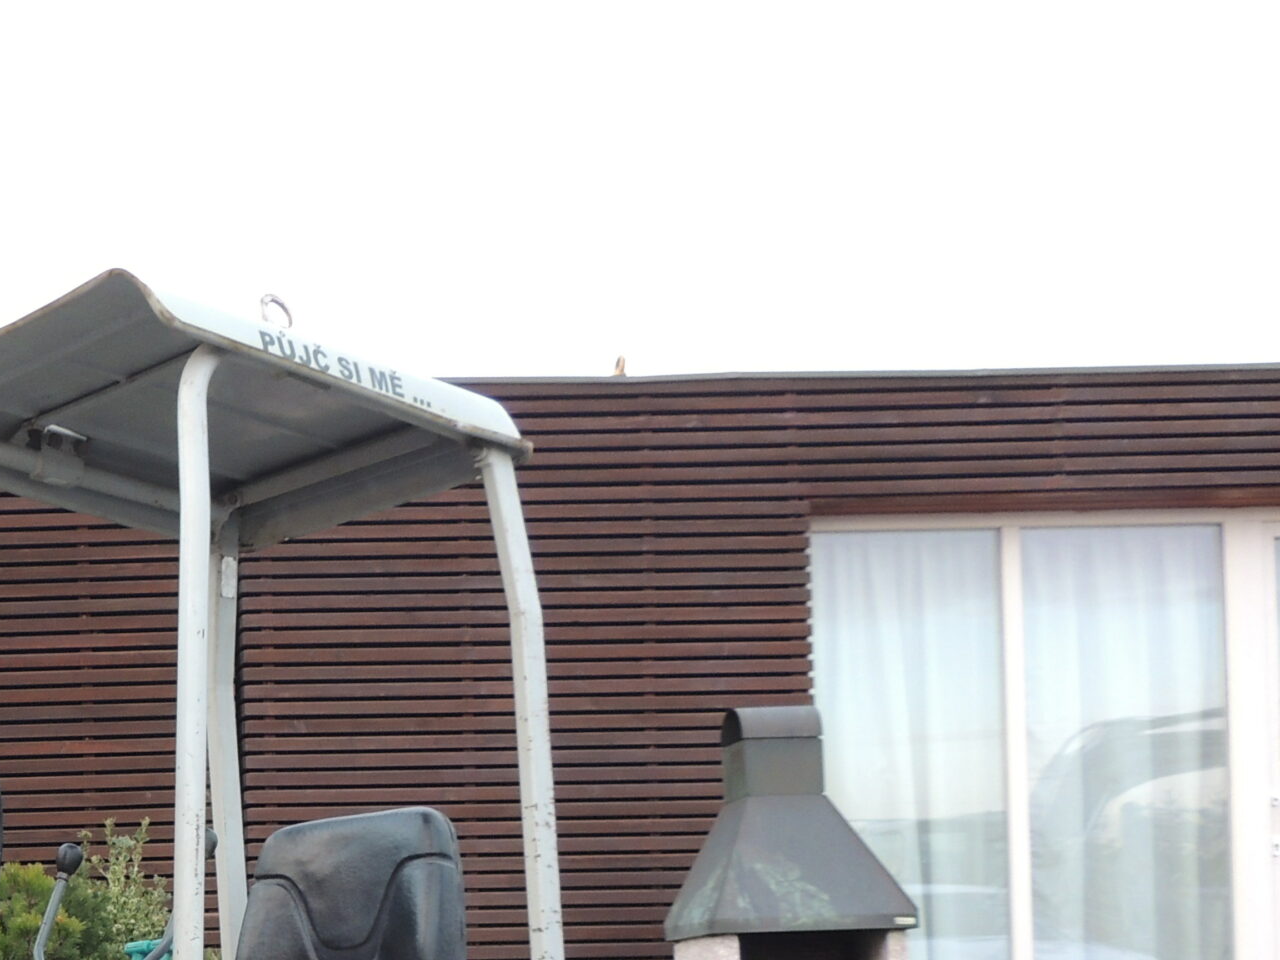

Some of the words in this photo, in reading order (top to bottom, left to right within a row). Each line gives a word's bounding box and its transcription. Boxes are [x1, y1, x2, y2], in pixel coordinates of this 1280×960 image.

[259, 330, 330, 372] PŮJČ
[337, 356, 362, 383] SI
[368, 366, 405, 399] MĚ
